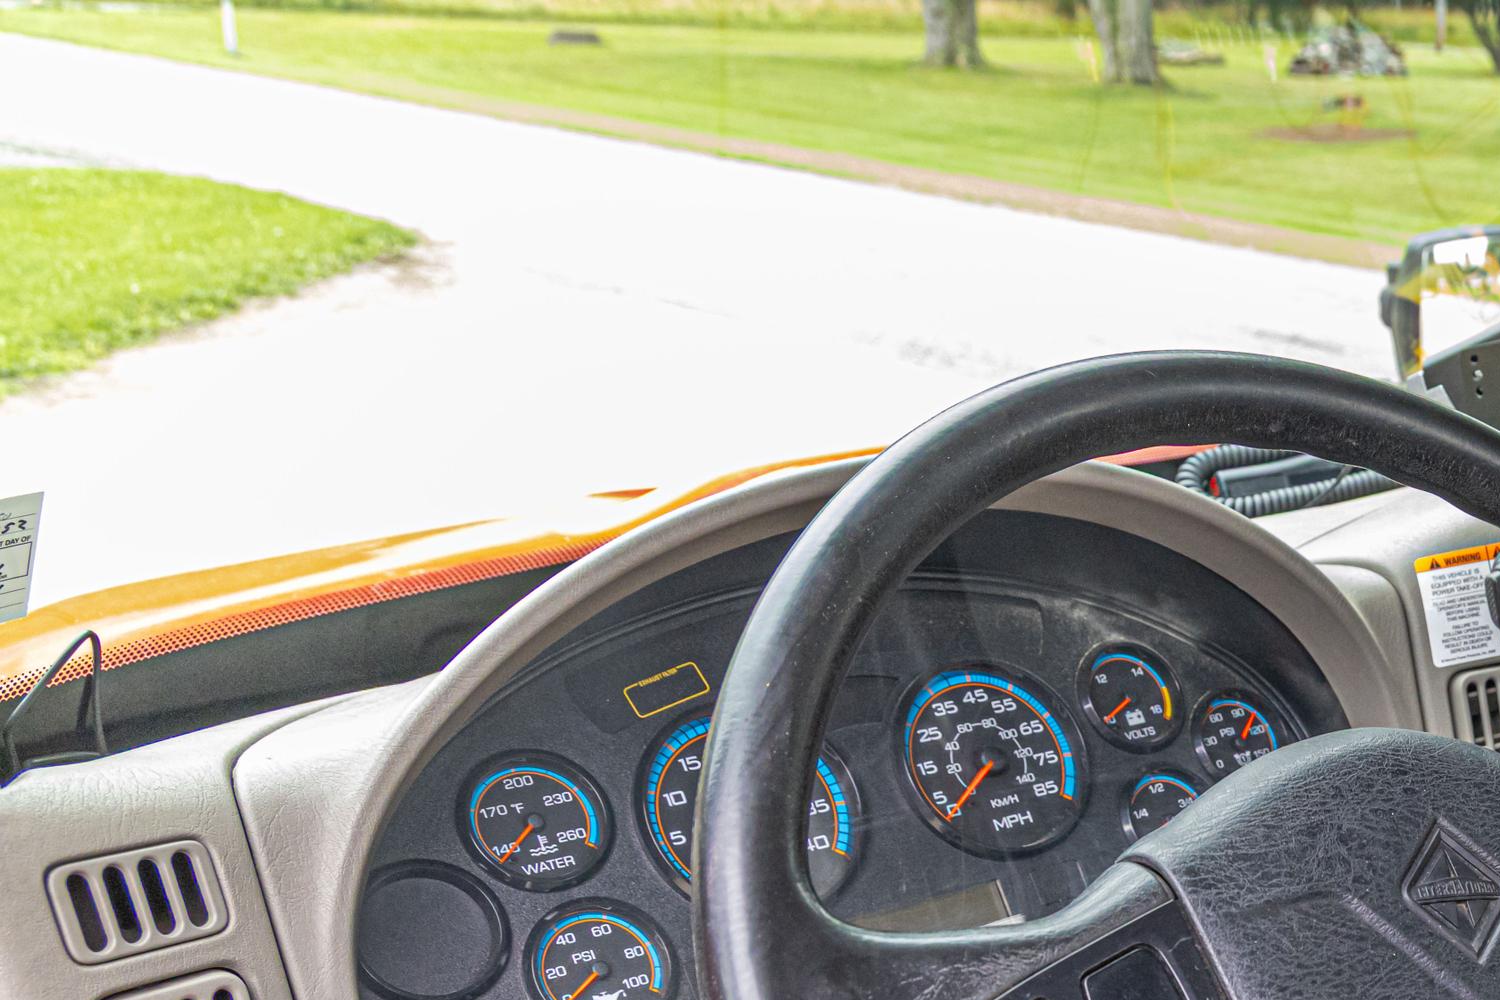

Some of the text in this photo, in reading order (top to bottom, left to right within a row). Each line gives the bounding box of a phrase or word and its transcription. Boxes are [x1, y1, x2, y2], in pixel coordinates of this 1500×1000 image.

[1095, 674, 1108, 684] 12
[1131, 667, 1144, 677] 14
[962, 689, 989, 704] 45
[932, 701, 958, 717] 35
[991, 698, 1017, 714] 55
[1149, 704, 1163, 715] 16
[1230, 707, 1246, 719] 90
[981, 717, 997, 729] 80
[1209, 712, 1224, 724] 60
[957, 722, 973, 734] 60
[998, 728, 1018, 740] 100
[1019, 719, 1044, 736] 65
[1124, 726, 1156, 741] VOLTS
[1219, 727, 1236, 739] PSI
[1250, 724, 1266, 736] 120
[917, 727, 942, 743] 25
[1203, 735, 1218, 747] 30
[944, 741, 960, 751] 40
[1014, 747, 1033, 759] 120
[678, 755, 702, 772] 15
[1033, 750, 1059, 767] 75
[1215, 759, 1225, 769] 0
[917, 761, 938, 776] 15
[946, 762, 962, 774] 20
[502, 774, 534, 790] 200
[1016, 772, 1036, 785] 140
[1033, 780, 1059, 797] 85
[1148, 782, 1165, 794] 1/2
[543, 791, 573, 806] 230
[662, 790, 687, 807] 10
[932, 791, 948, 804] 5
[480, 804, 508, 819] 170
[1133, 808, 1149, 820] 1/4
[992, 810, 1034, 831] MPH
[557, 828, 587, 843] 260
[669, 830, 687, 846] 5
[521, 855, 576, 875] WATER
[591, 924, 612, 937] 60
[556, 932, 576, 946] 40
[571, 950, 596, 964] PSI
[624, 945, 645, 959] 80
[546, 965, 567, 980] 20
[622, 974, 650, 989] 100
